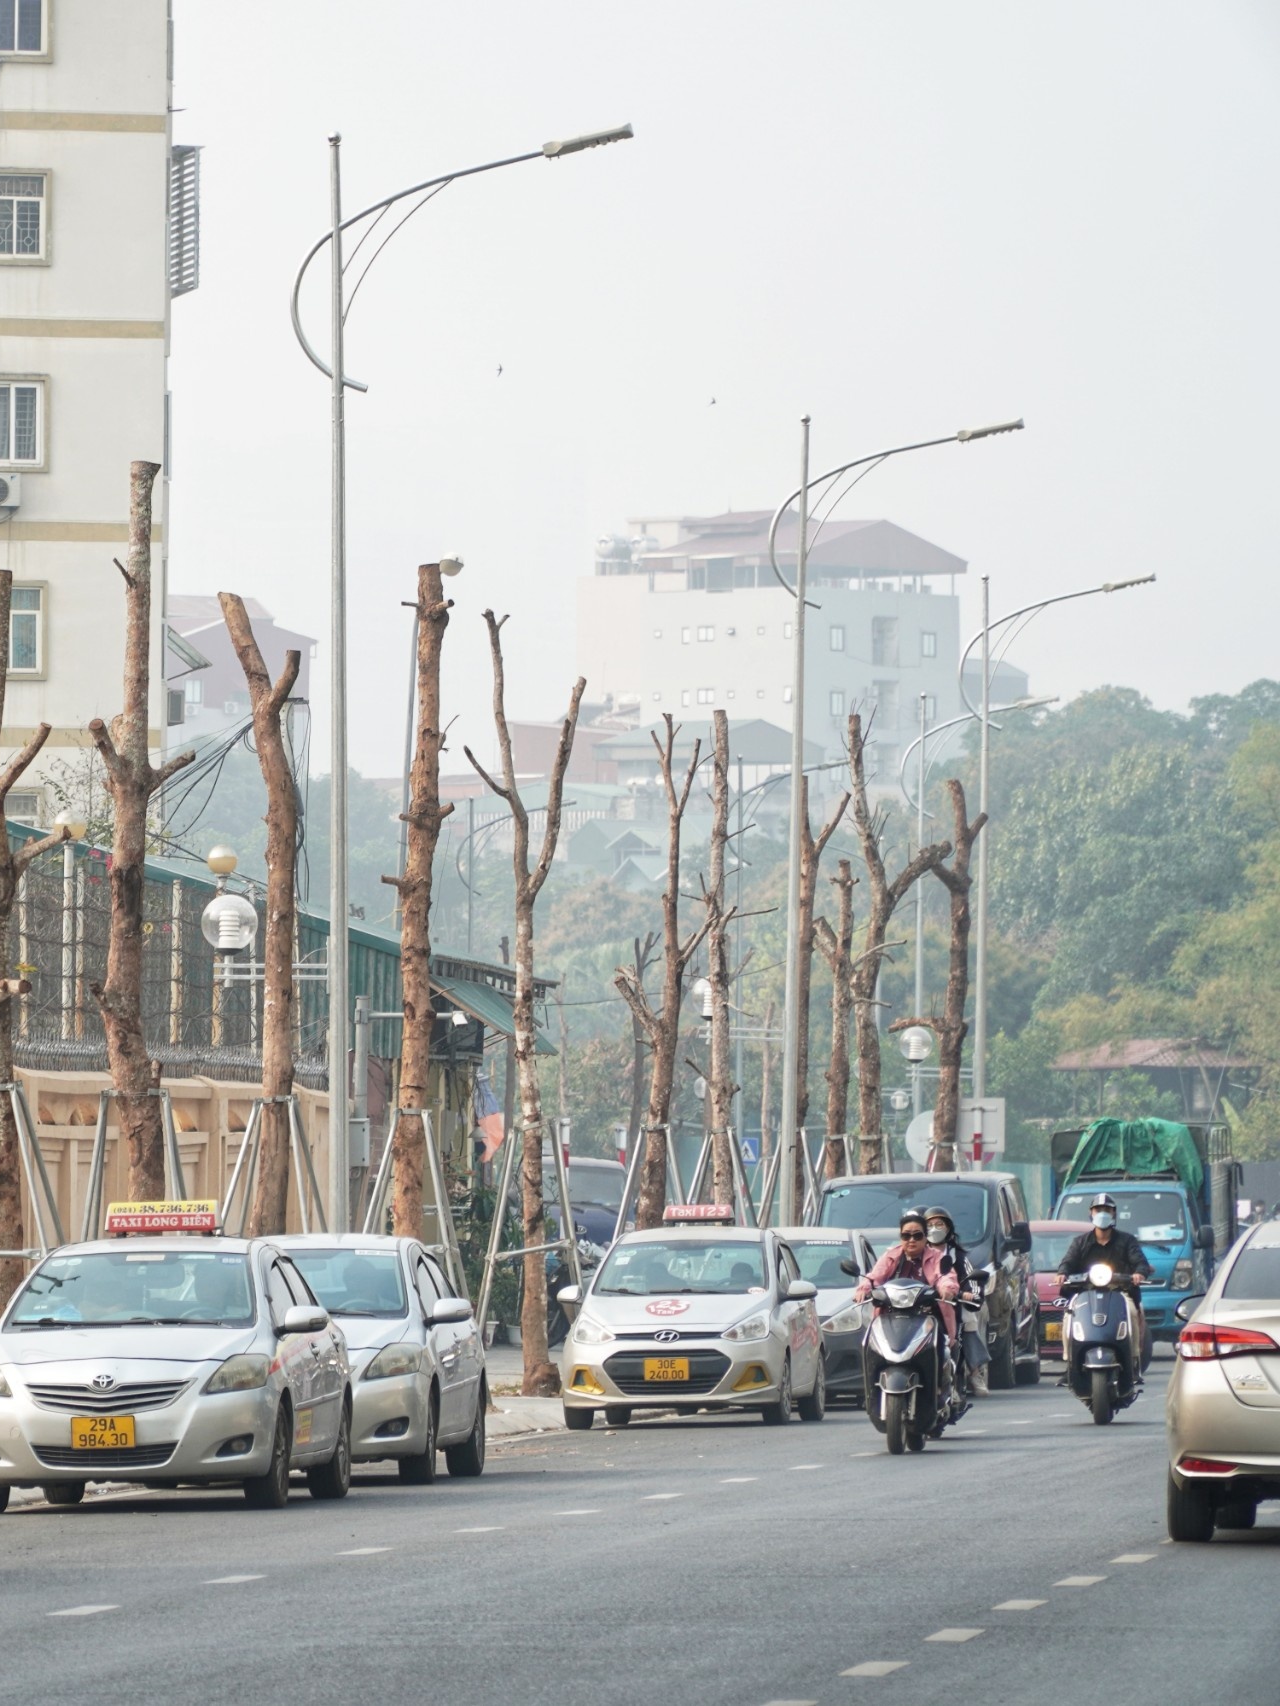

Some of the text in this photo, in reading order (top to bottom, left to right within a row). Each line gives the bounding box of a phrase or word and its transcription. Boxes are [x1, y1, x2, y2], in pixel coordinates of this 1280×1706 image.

[113, 1203, 210, 1214] (024) 38.736.736
[670, 1206, 727, 1217] Taxi 123
[112, 1214, 211, 1227] TAXI LONG BIÊN
[657, 1359, 676, 1369] 30E
[649, 1369, 685, 1380] 240.00
[89, 1418, 116, 1432] 29A
[78, 1433, 129, 1447] 984.30
